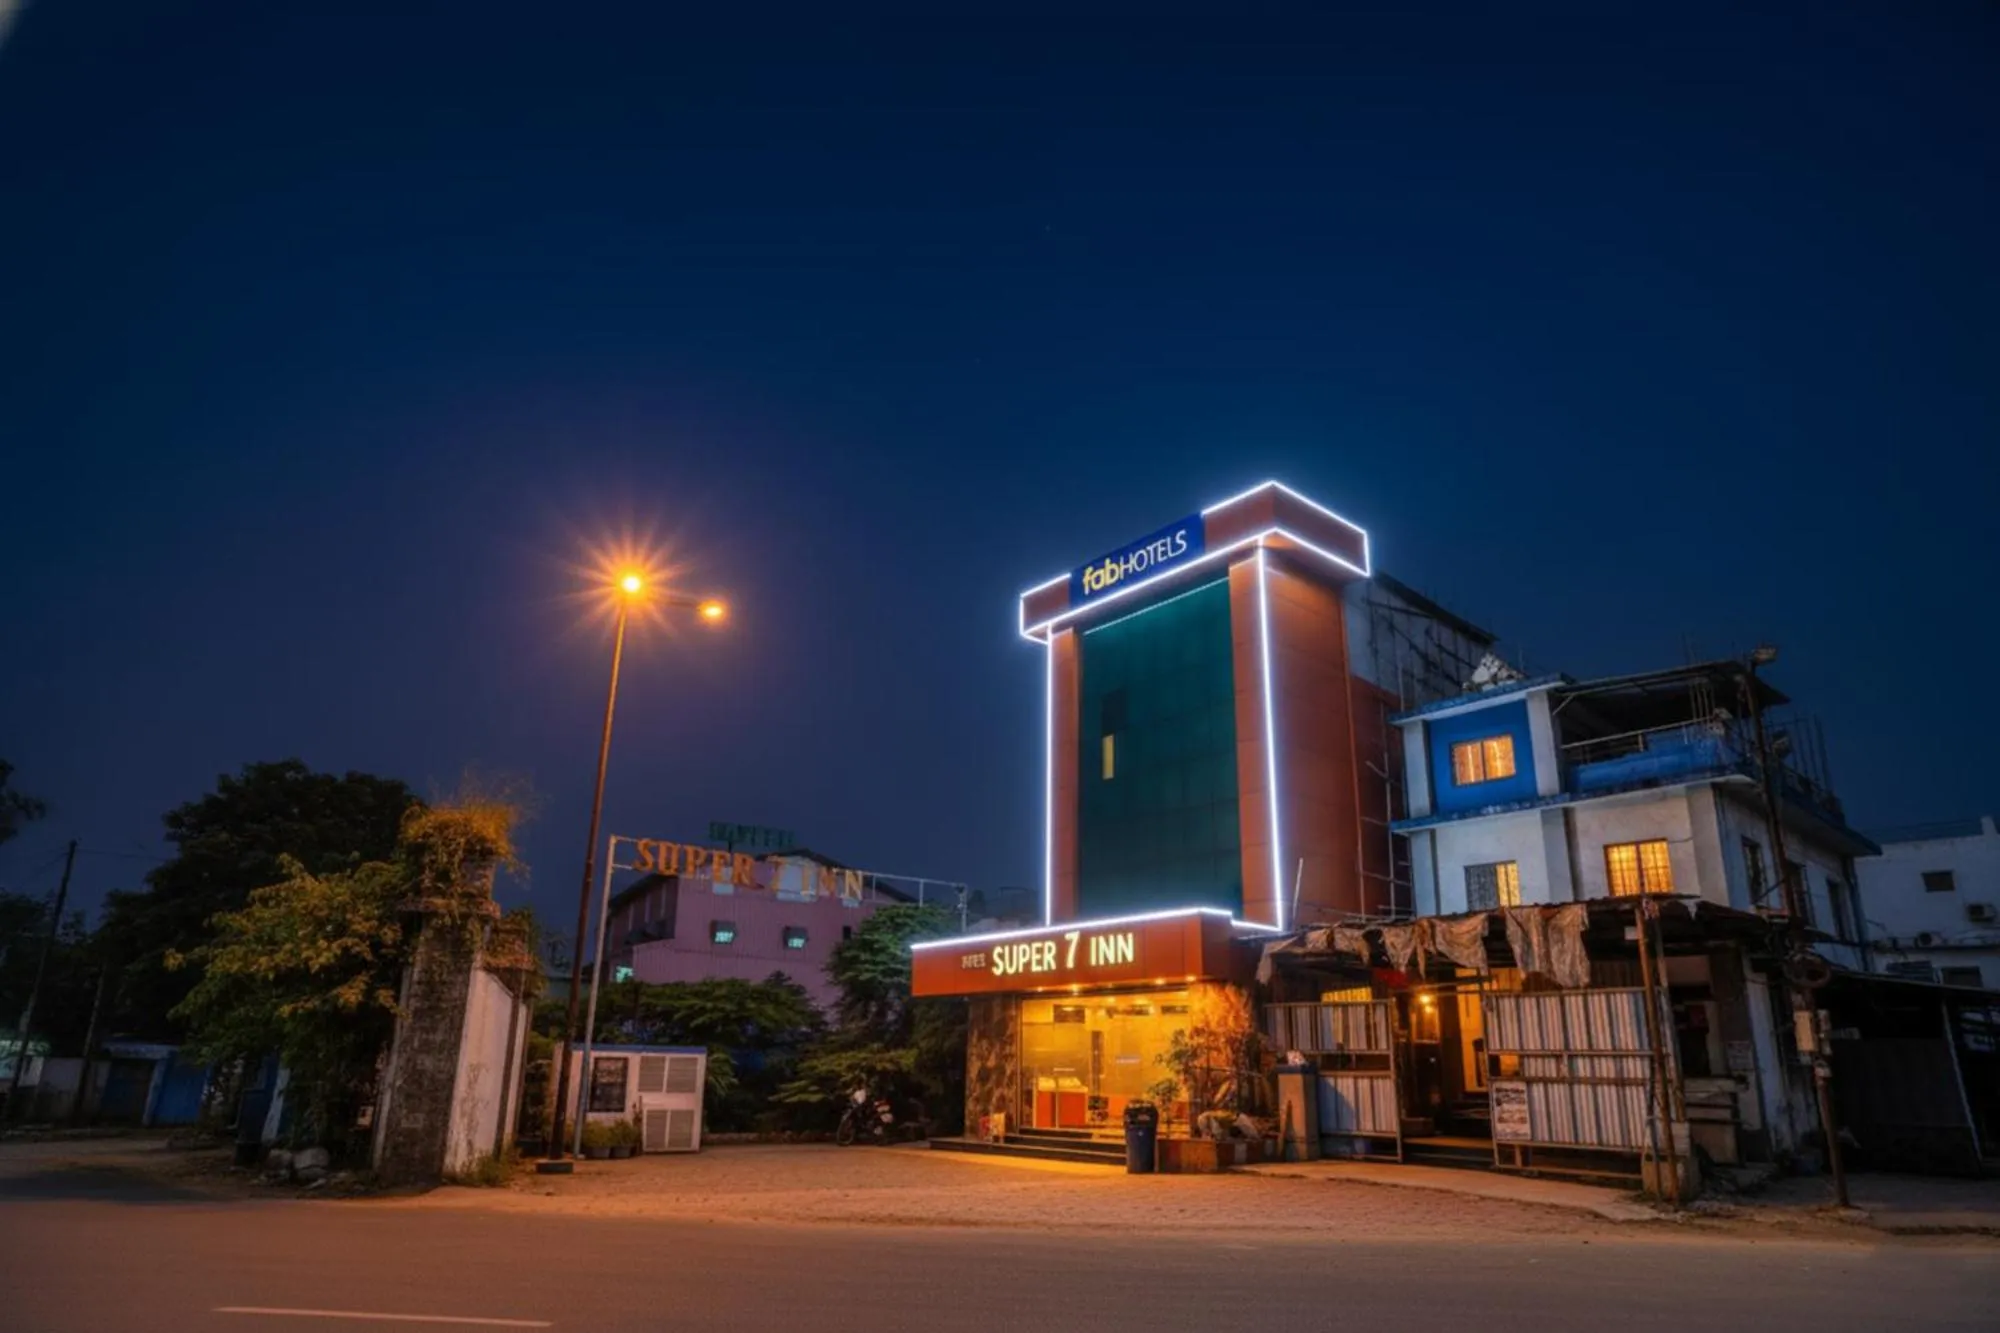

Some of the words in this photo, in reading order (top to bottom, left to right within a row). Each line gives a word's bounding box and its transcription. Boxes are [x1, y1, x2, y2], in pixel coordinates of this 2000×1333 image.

[632, 837, 756, 886] SUPER
[991, 940, 1057, 977] SUPER
[1063, 930, 1081, 969] 7
[1089, 932, 1134, 967] INN
